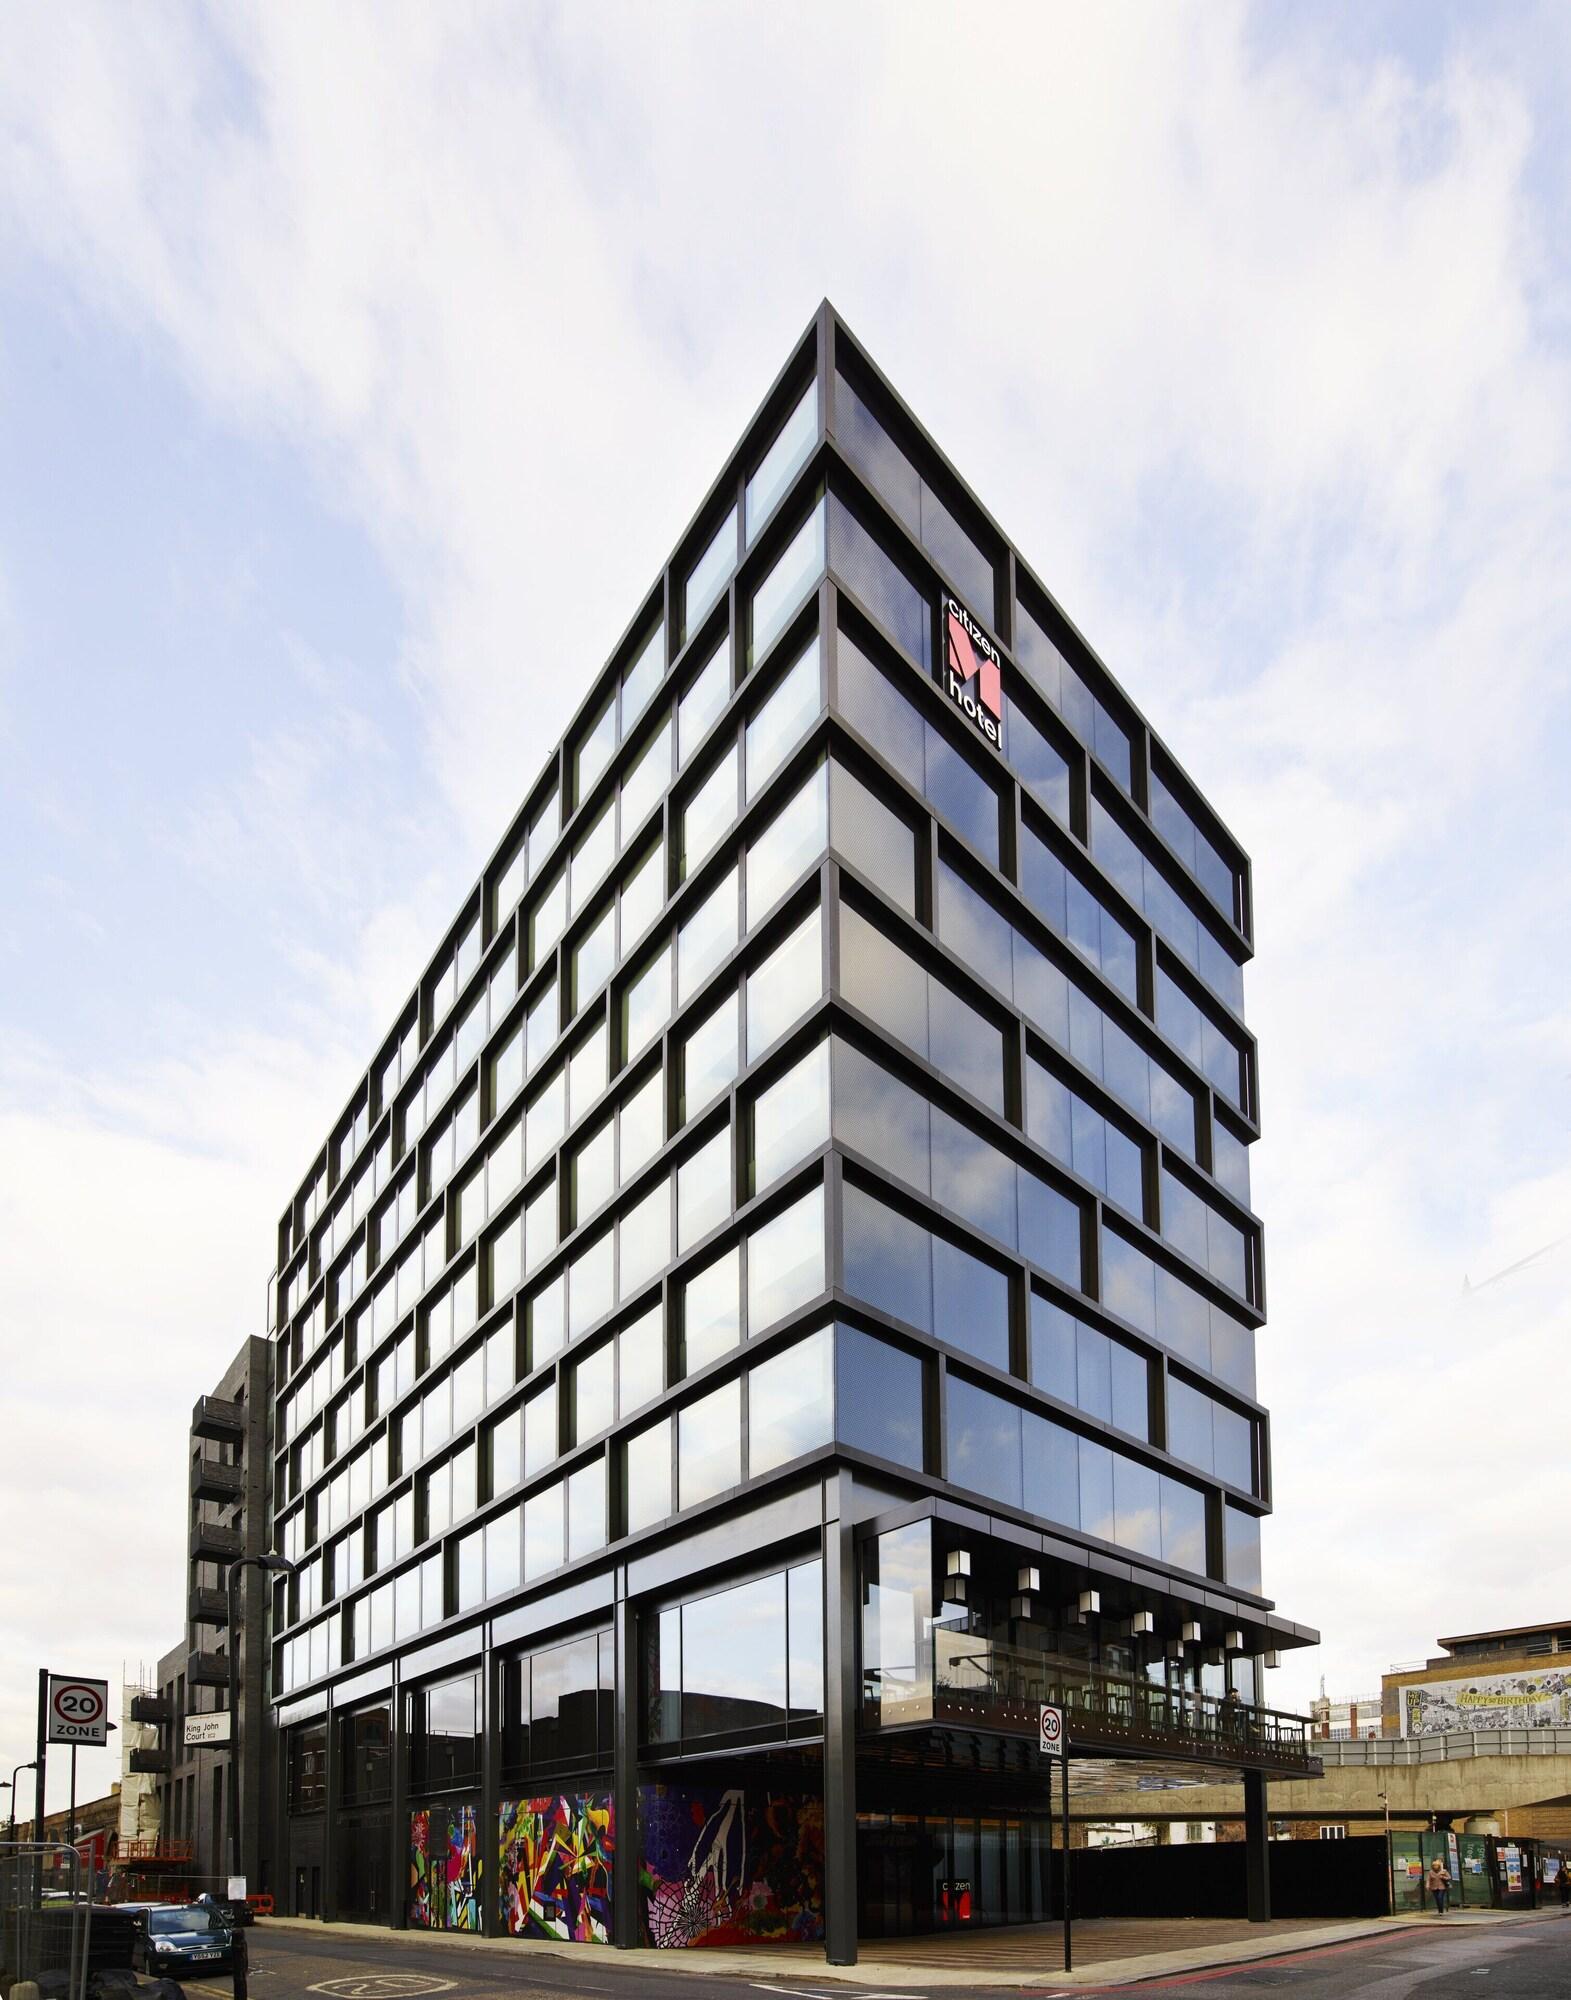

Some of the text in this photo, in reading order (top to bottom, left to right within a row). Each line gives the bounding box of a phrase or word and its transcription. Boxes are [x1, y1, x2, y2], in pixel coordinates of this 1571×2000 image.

[948, 599, 1001, 669] citizen
[949, 669, 1002, 749] hotel
[62, 1695, 96, 1714] 20
[1460, 1693, 1489, 1705] HAPPY
[1497, 1692, 1543, 1706] BIRTHDAY
[56, 1724, 100, 1737] ZONE
[186, 1722, 219, 1733] King John
[1045, 1717, 1058, 1732] 20
[185, 1732, 206, 1741] Court
[1042, 1740, 1060, 1752] ZONE
[942, 1882, 970, 1891] czen
[331, 1977, 432, 1995] 20
